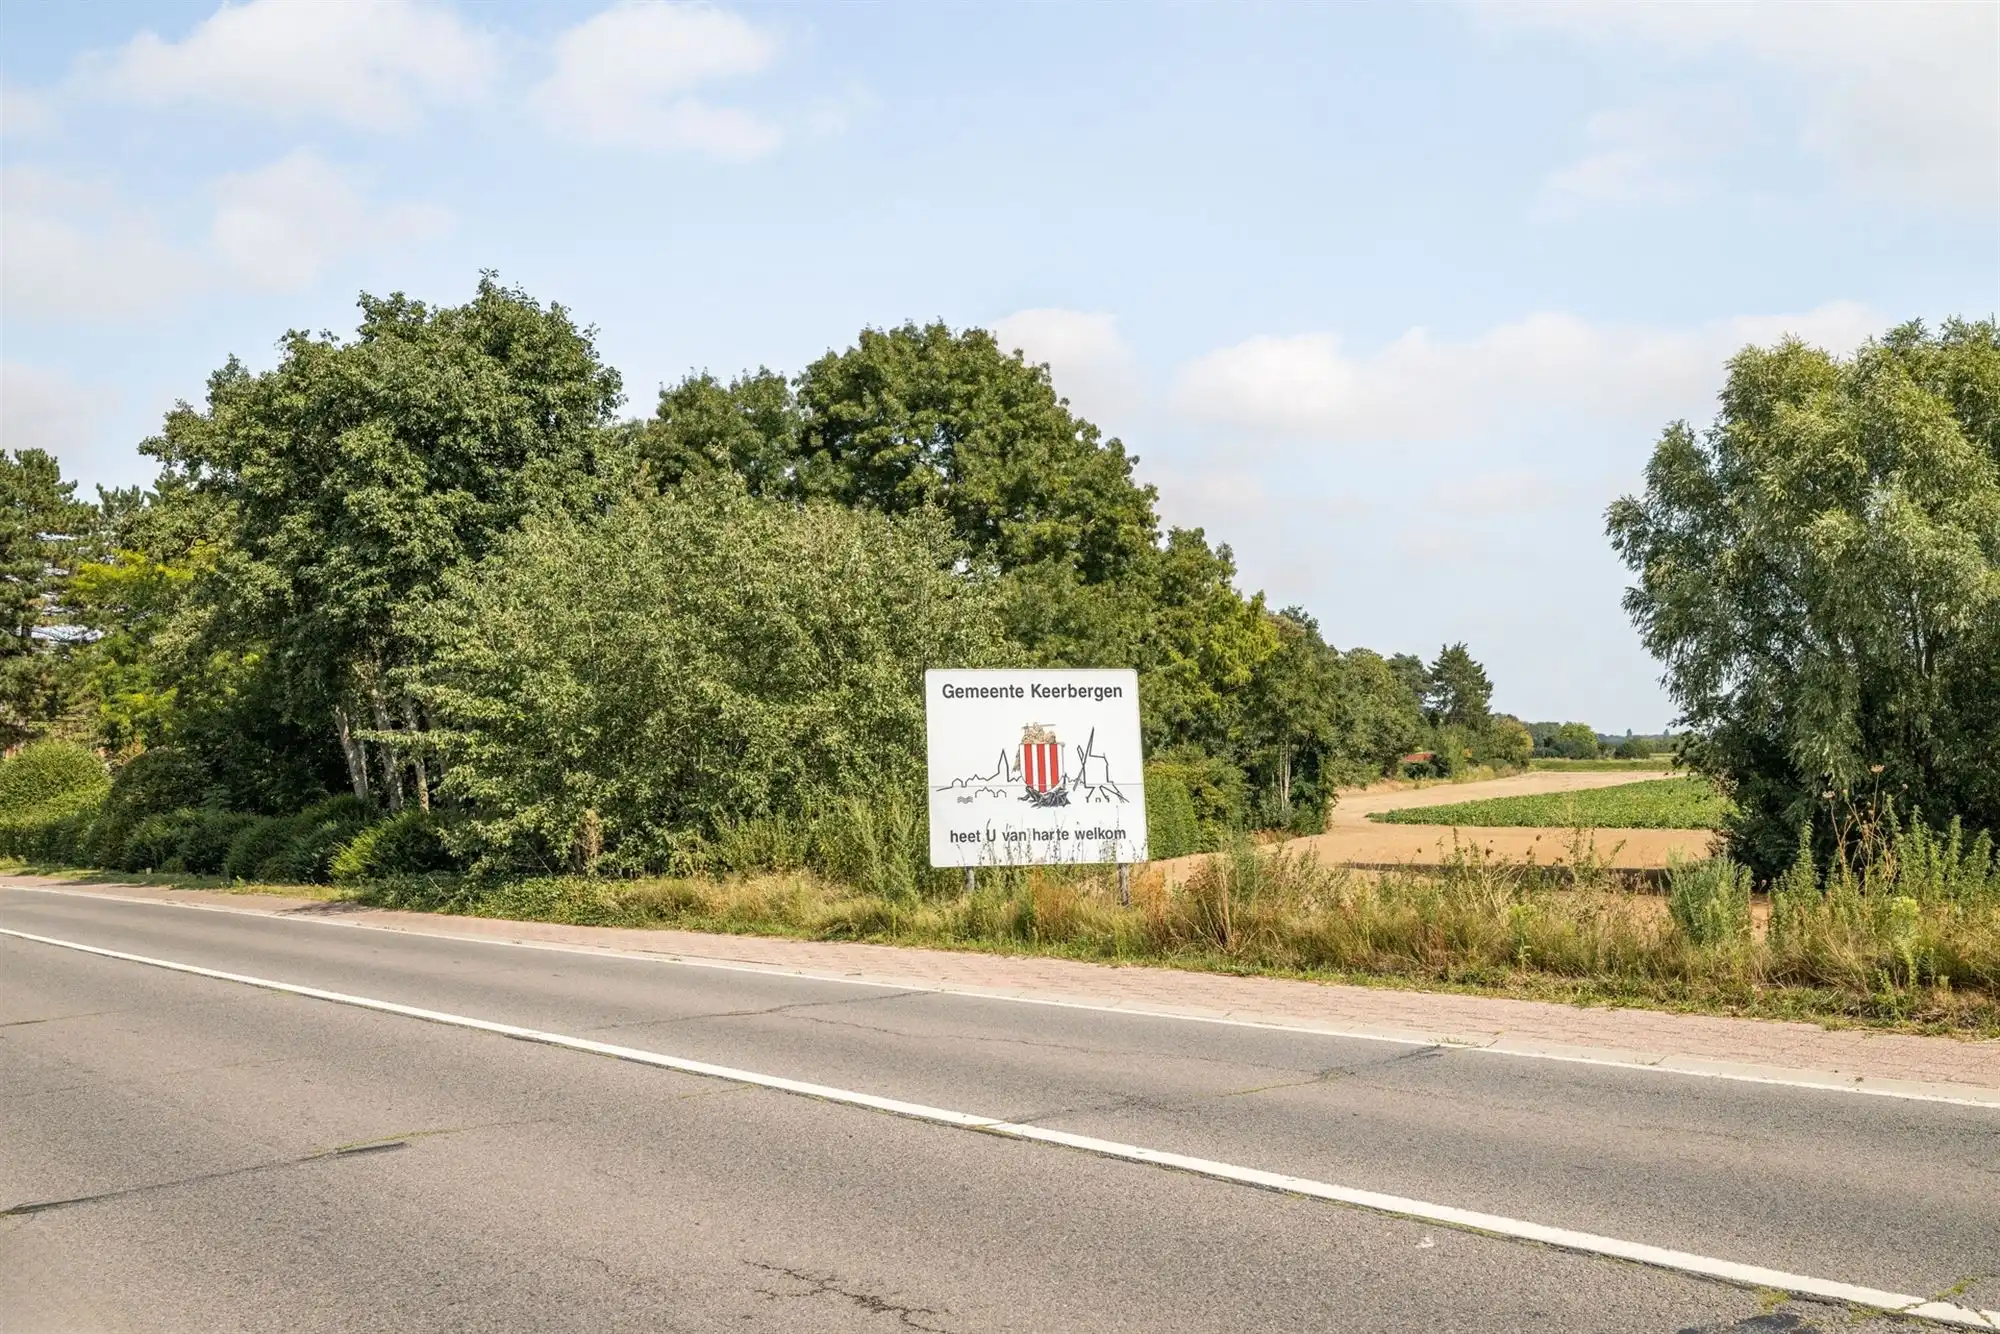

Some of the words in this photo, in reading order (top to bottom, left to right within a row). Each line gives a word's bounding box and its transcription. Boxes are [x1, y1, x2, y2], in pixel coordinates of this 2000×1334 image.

[942, 683, 1024, 699] Gemeente
[1031, 683, 1122, 702] Keerbergen
[950, 830, 981, 843] heet
[986, 829, 996, 842] U
[1002, 830, 1026, 842] van
[1032, 828, 1069, 841] harte
[1075, 827, 1126, 841] welkom
